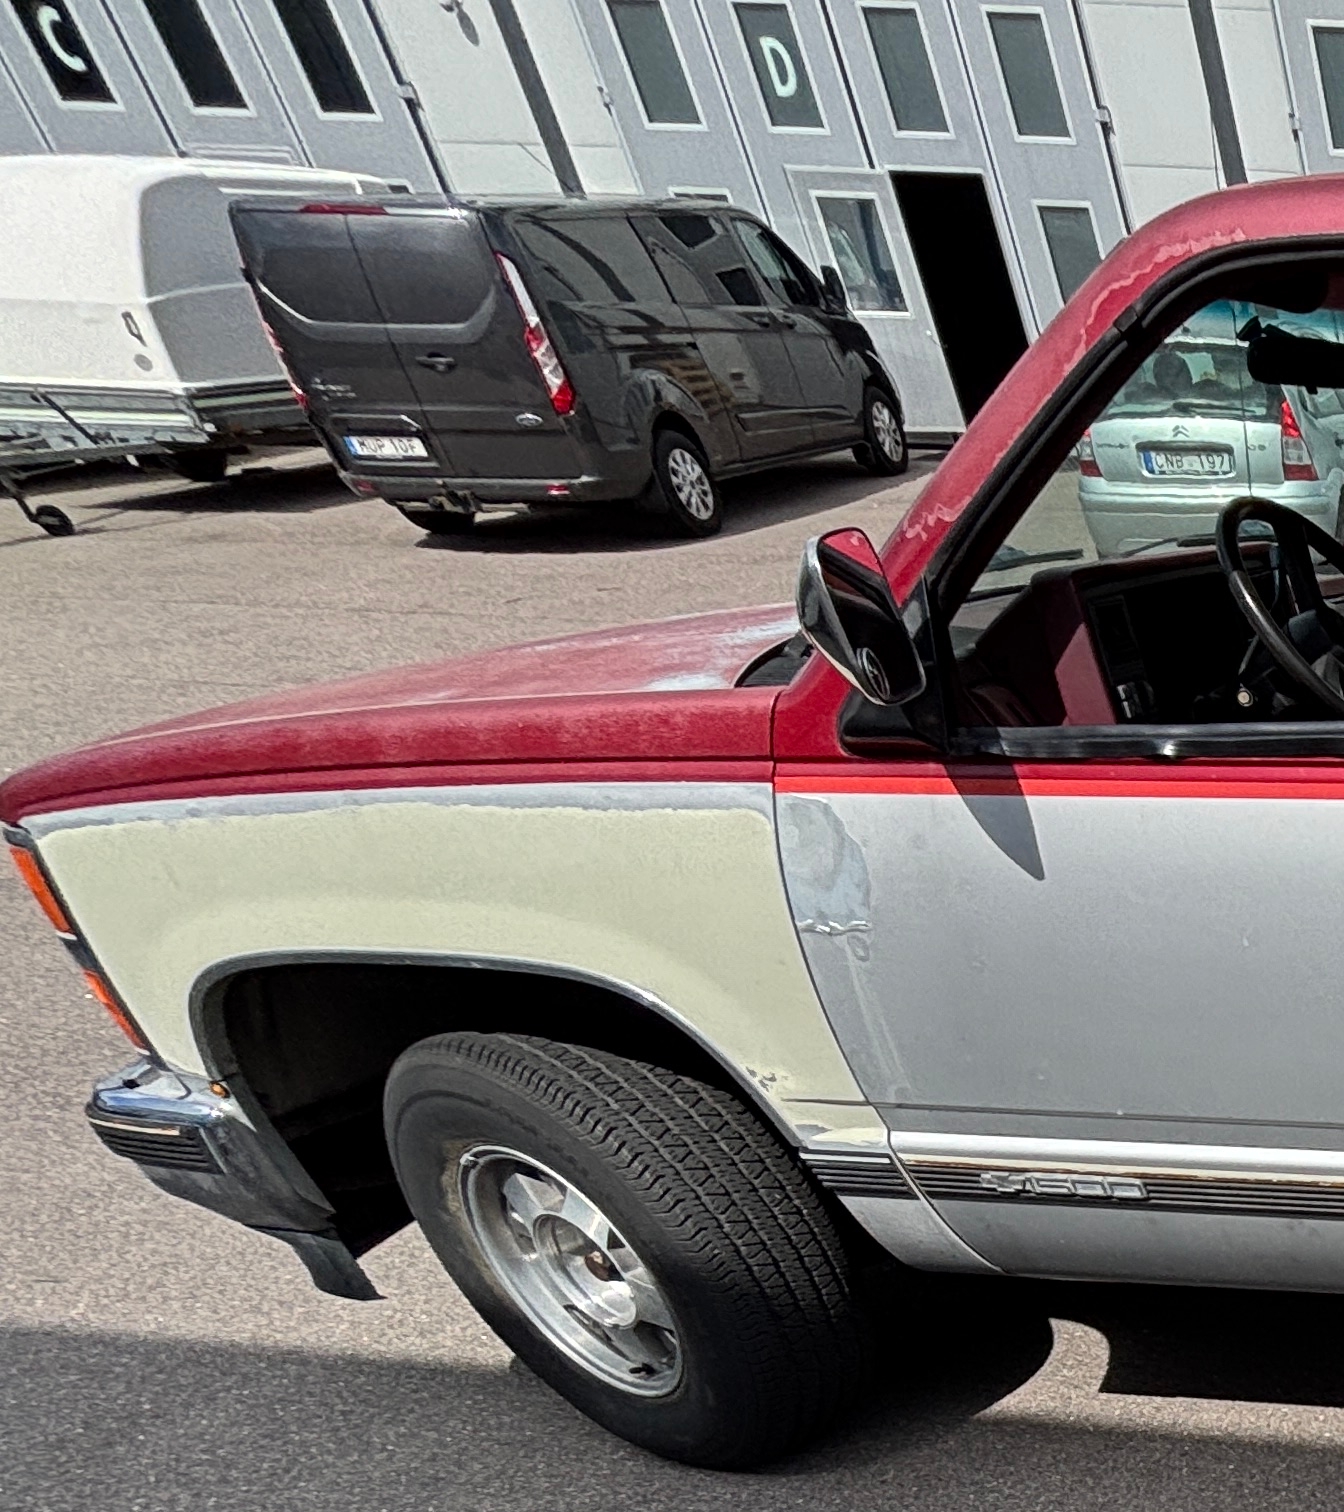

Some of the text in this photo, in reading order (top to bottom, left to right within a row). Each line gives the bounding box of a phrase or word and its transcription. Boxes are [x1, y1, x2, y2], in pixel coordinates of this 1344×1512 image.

[37, 5, 88, 71] C
[759, 36, 797, 97] D
[1154, 452, 1225, 470] CNB 197
